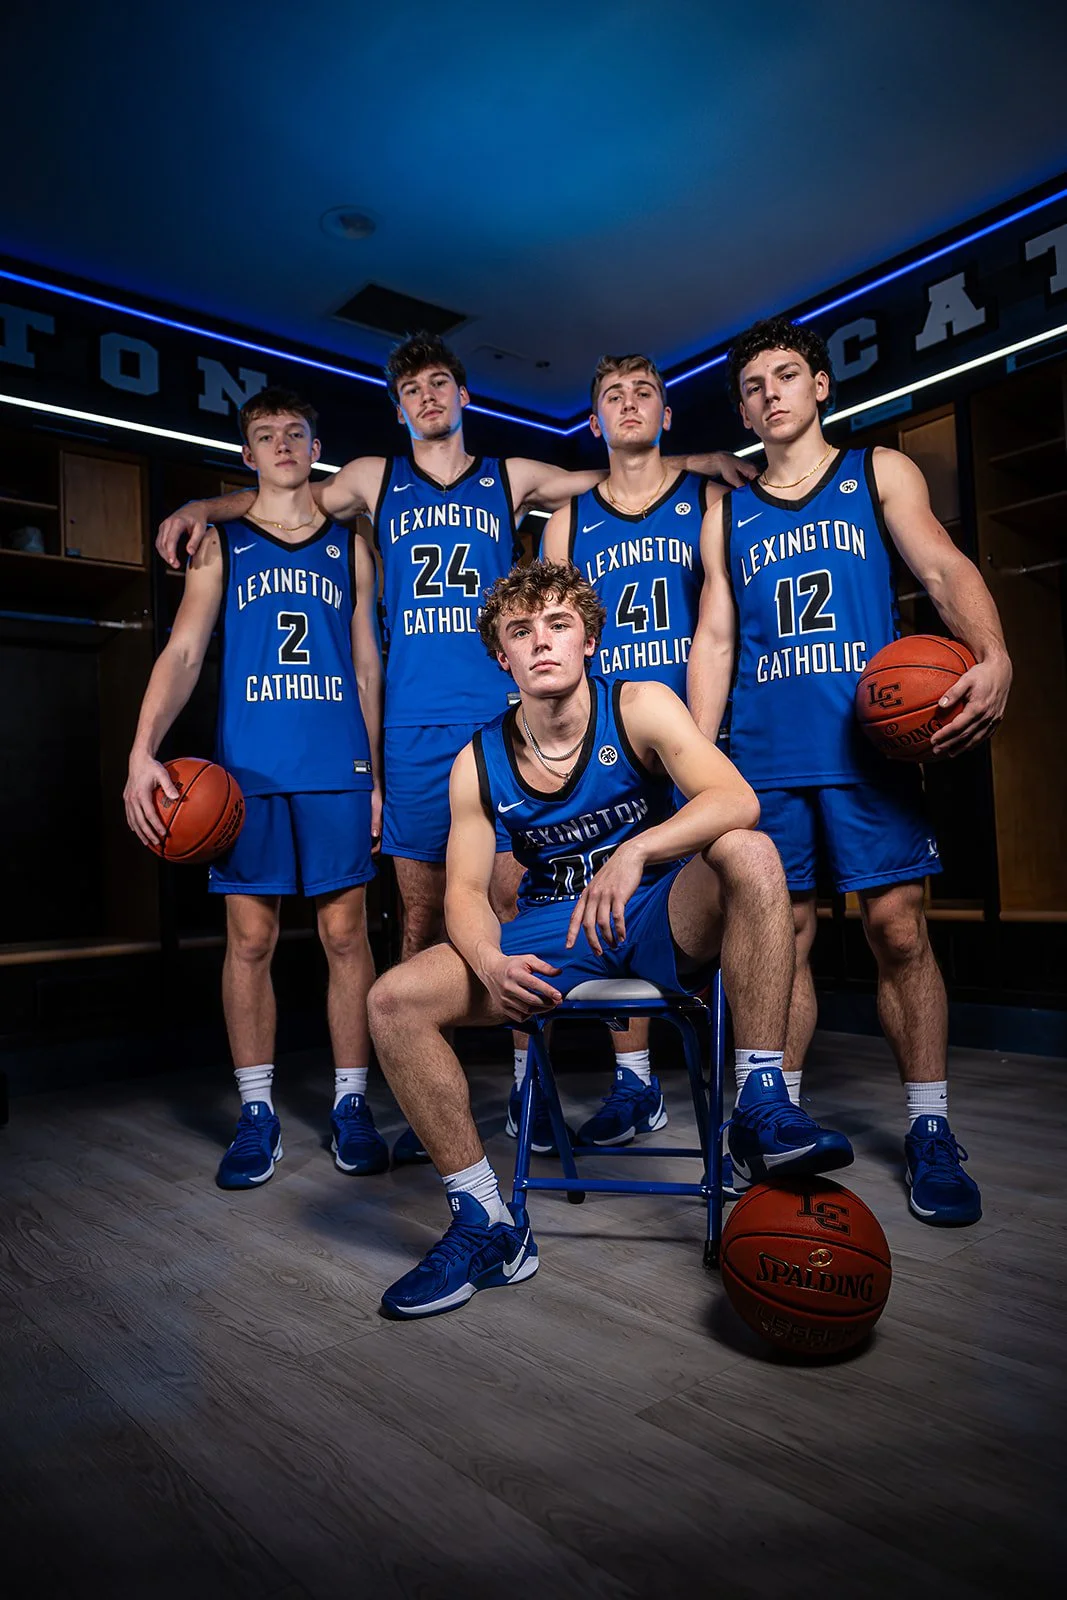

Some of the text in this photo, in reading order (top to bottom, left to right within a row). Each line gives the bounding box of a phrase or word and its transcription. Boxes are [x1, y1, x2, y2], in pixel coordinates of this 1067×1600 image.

[390, 502, 500, 545] LEXINGTON
[410, 543, 481, 599] 24
[586, 536, 694, 587] LEXINGTON
[740, 519, 867, 587] LEXINGTON
[237, 567, 343, 612] LEXINGTON
[615, 576, 671, 634] 41
[774, 568, 837, 638] 12
[277, 610, 310, 665] 2
[599, 637, 693, 675] CATHOLIC
[756, 640, 868, 684] CATHOLIC
[246, 673, 343, 702] CATHOLIC
[518, 797, 650, 849] EXINGTON
[756, 1251, 875, 1303] SPALDING
